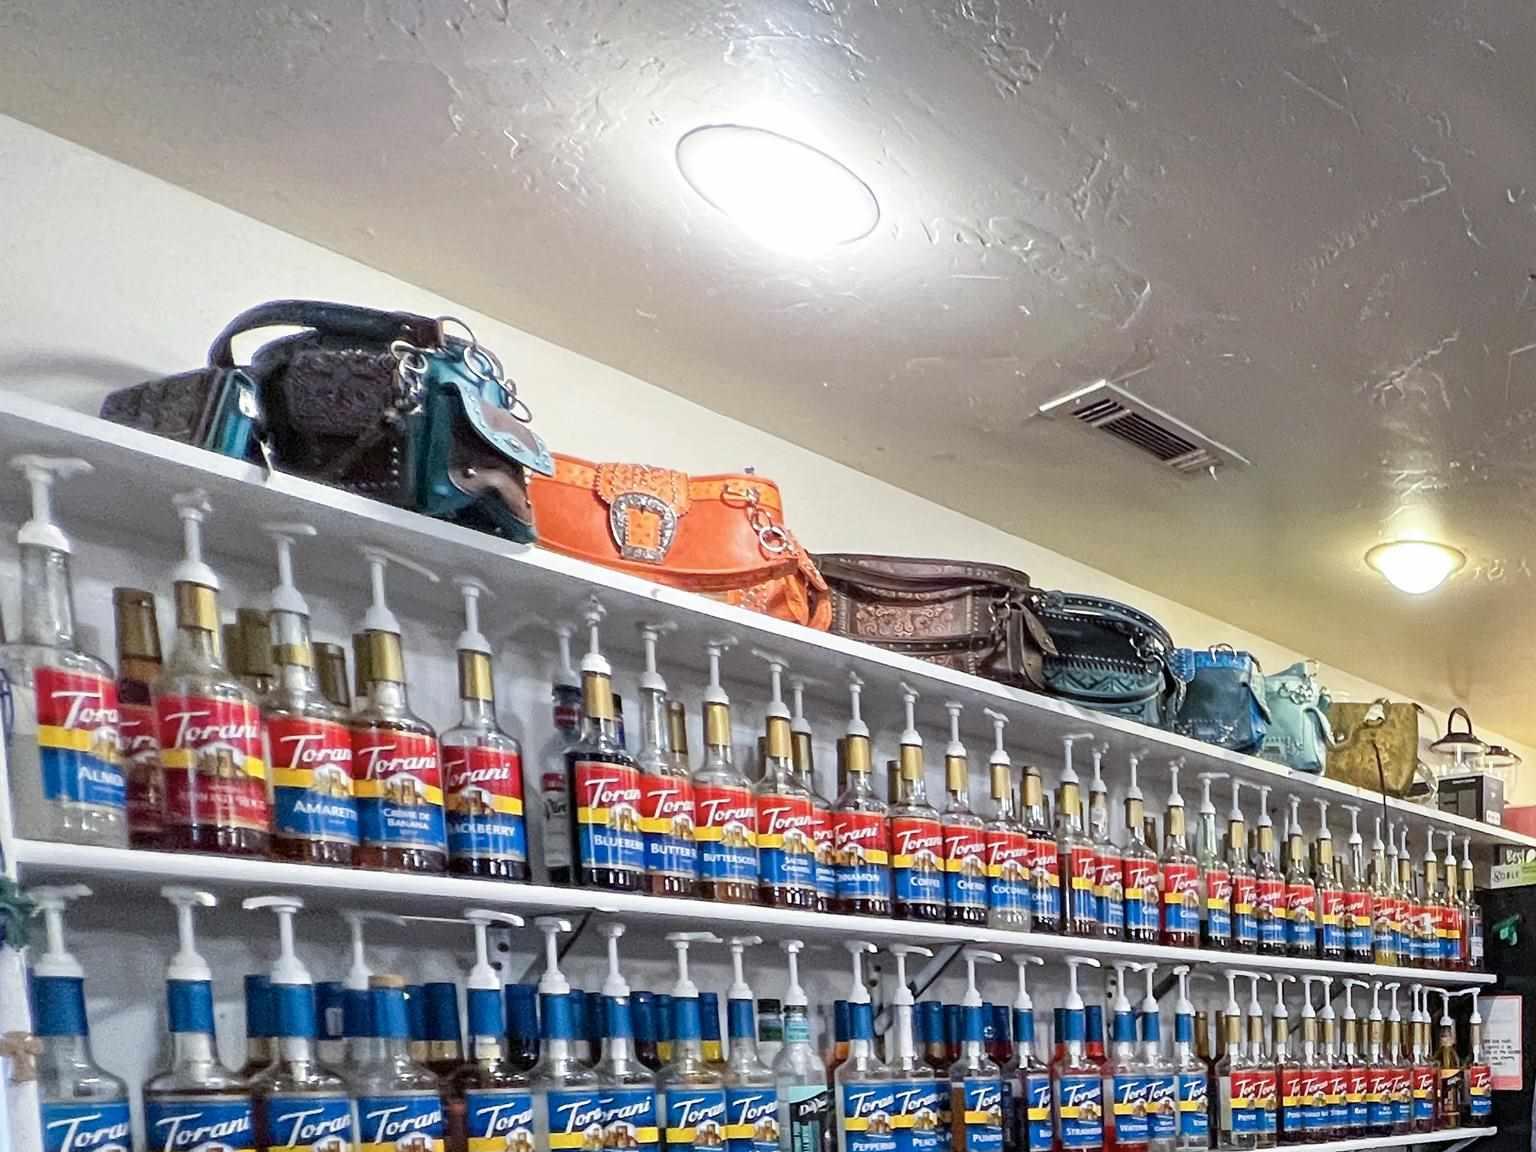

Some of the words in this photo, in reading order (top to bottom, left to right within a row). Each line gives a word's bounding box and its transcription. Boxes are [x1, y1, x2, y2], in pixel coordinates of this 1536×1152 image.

[51, 690, 120, 730] Tora
[164, 711, 259, 748] Torani
[280, 734, 352, 769] Toran
[358, 744, 437, 781] Torani
[700, 798, 756, 829] Toran
[762, 806, 812, 835] Toran
[276, 1107, 351, 1149] Toran
[476, 1102, 533, 1139] Tora
